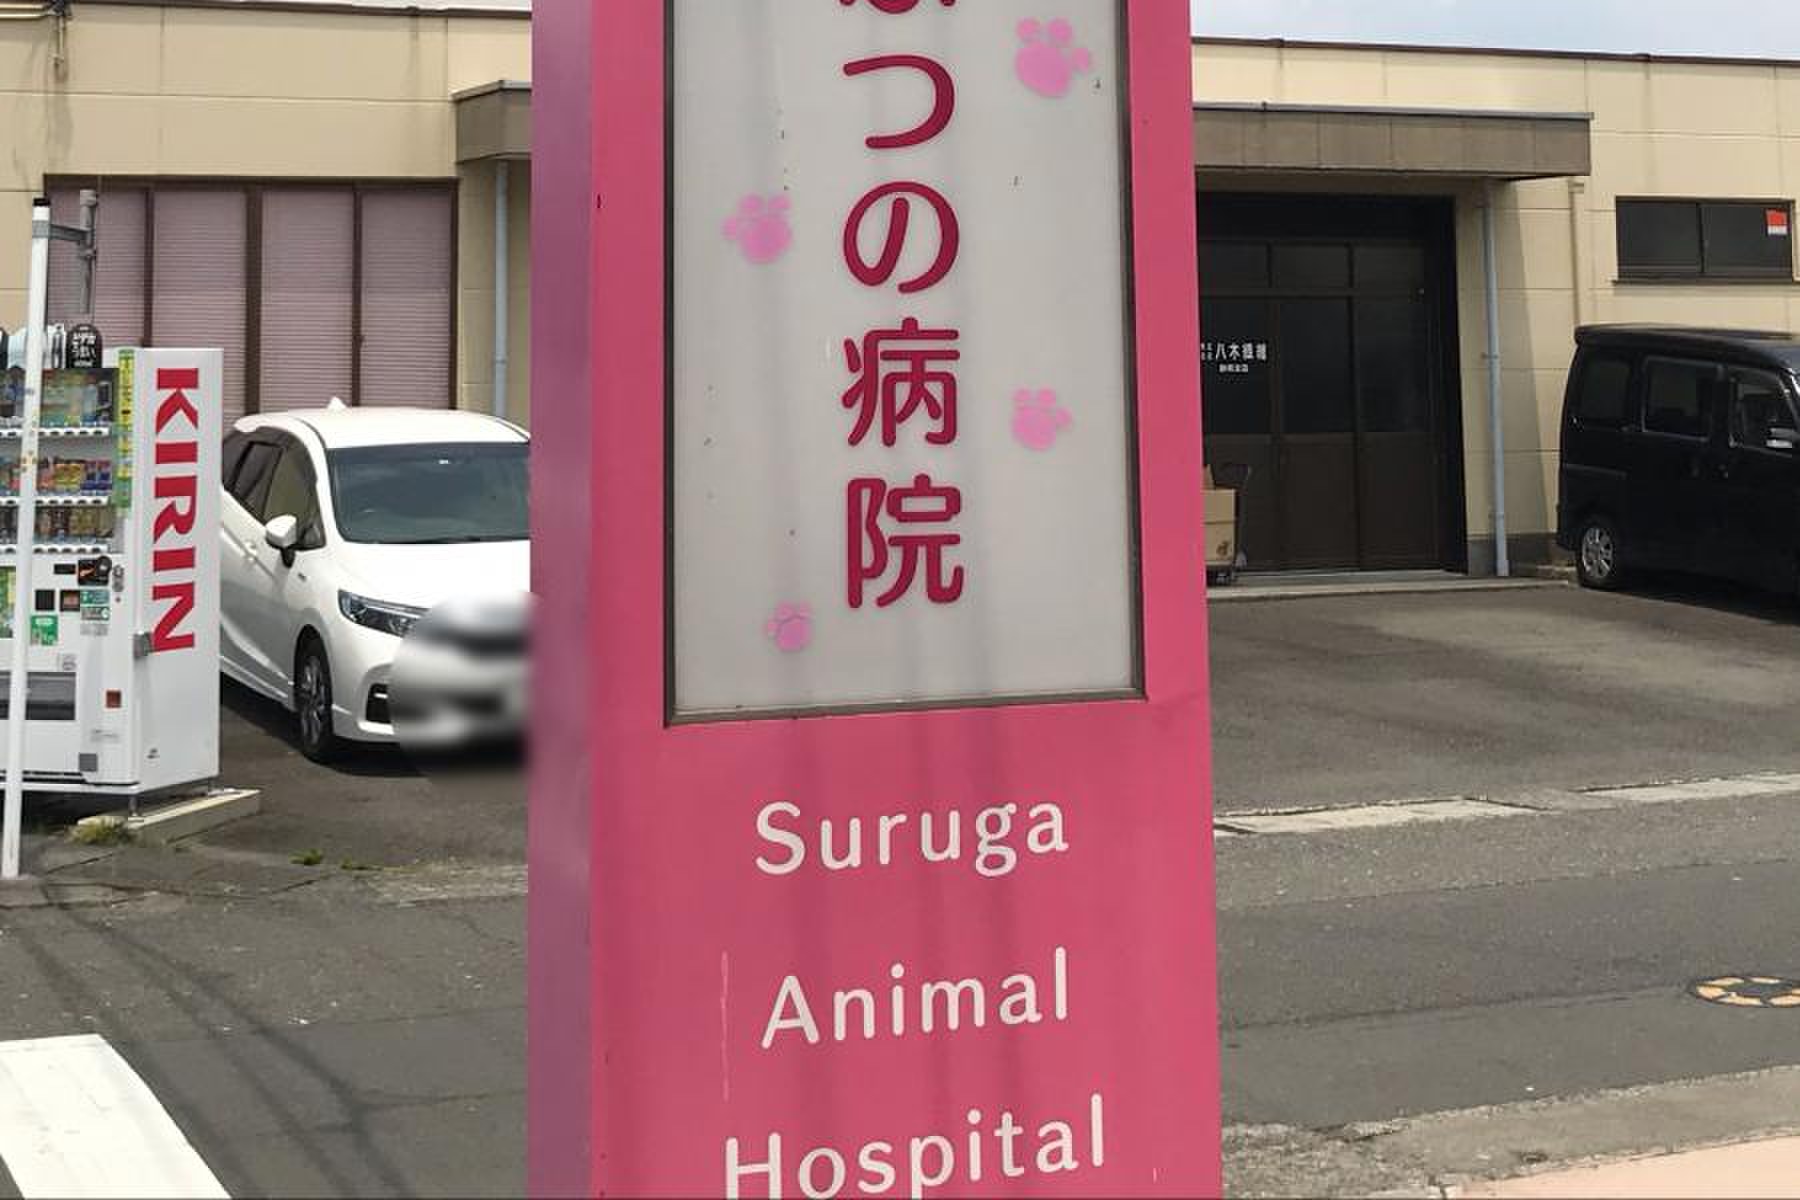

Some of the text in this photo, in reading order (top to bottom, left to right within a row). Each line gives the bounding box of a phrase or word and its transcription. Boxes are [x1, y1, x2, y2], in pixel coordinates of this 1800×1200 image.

[152, 367, 199, 654] KIRIN
[755, 801, 1069, 878] Suruga
[761, 946, 1068, 1049] Animal
[725, 1092, 1104, 1200] Hospital
